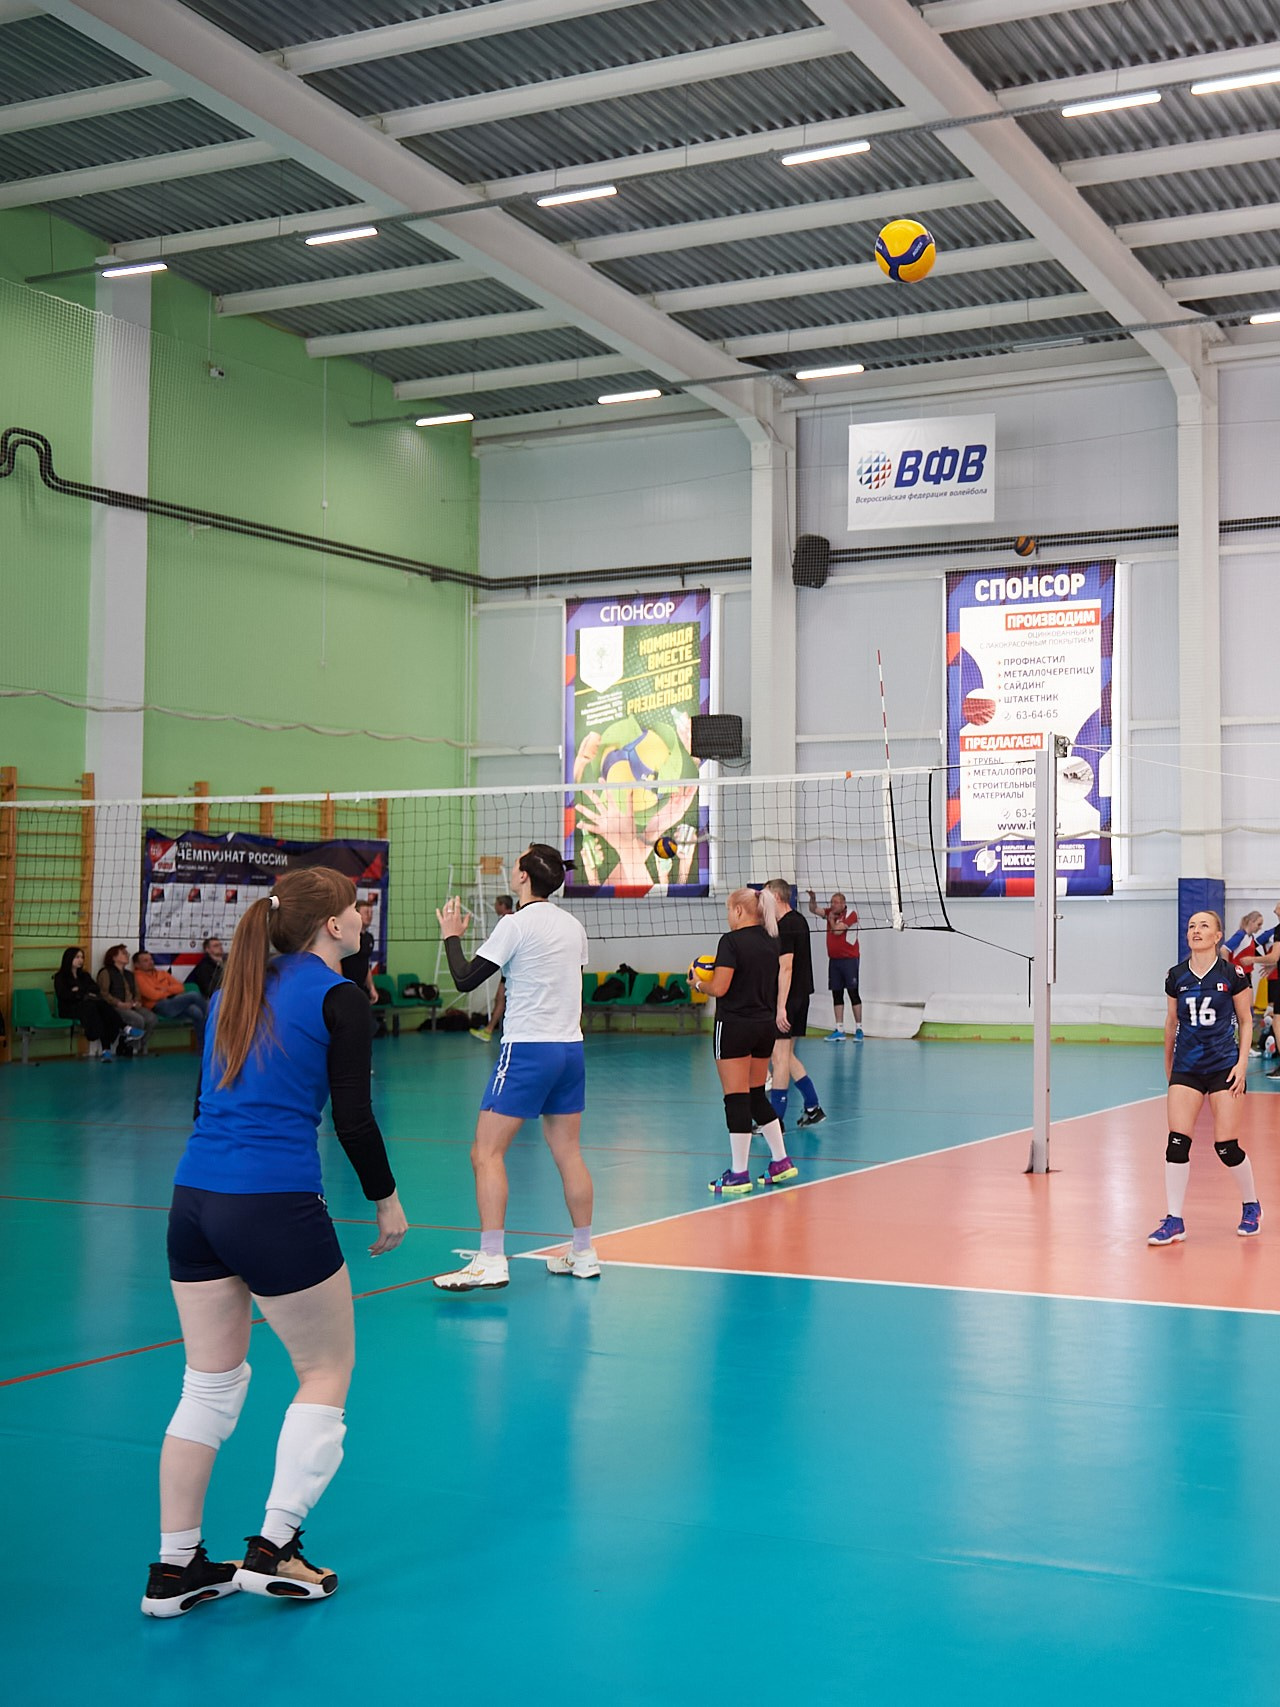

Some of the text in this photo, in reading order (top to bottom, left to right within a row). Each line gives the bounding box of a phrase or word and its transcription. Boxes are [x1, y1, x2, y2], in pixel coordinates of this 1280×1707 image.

[894, 444, 987, 488] ВФВ
[855, 488, 987, 503] Всероссийская федерация волейбола
[975, 573, 1085, 601] СПОНСОР
[600, 602, 675, 622] СПОНСОР
[1007, 611, 1095, 628] ПРОИЗВОДИМ
[640, 627, 693, 656] КОМАНДА
[1049, 637, 1094, 646] ПОКРЫТИЕМ
[648, 645, 692, 671] ВМЕСТЕ
[1003, 656, 1065, 666] ПРОФНАСТИЛ
[655, 666, 692, 691] МУСОР
[1003, 666, 1095, 678] МЕТАЛЛОЧЕРЕПИЦУ
[1004, 681, 1045, 690] САЙДИНГ
[627, 684, 692, 715] РАЗДЕЛЬНО
[1004, 695, 1058, 704] ШТАКЕТНИК
[1016, 709, 1058, 720] 63-64-65
[965, 736, 1041, 750] ПРЕДЛАГАЕМ
[973, 757, 1001, 765] ТРУБЫ
[973, 767, 1035, 777] МЕТАЛЛОПРО
[973, 791, 1024, 799] МАТЕРИАЛЫ
[248, 852, 288, 866] РОССИИ
[1186, 997, 1216, 1026] 16
